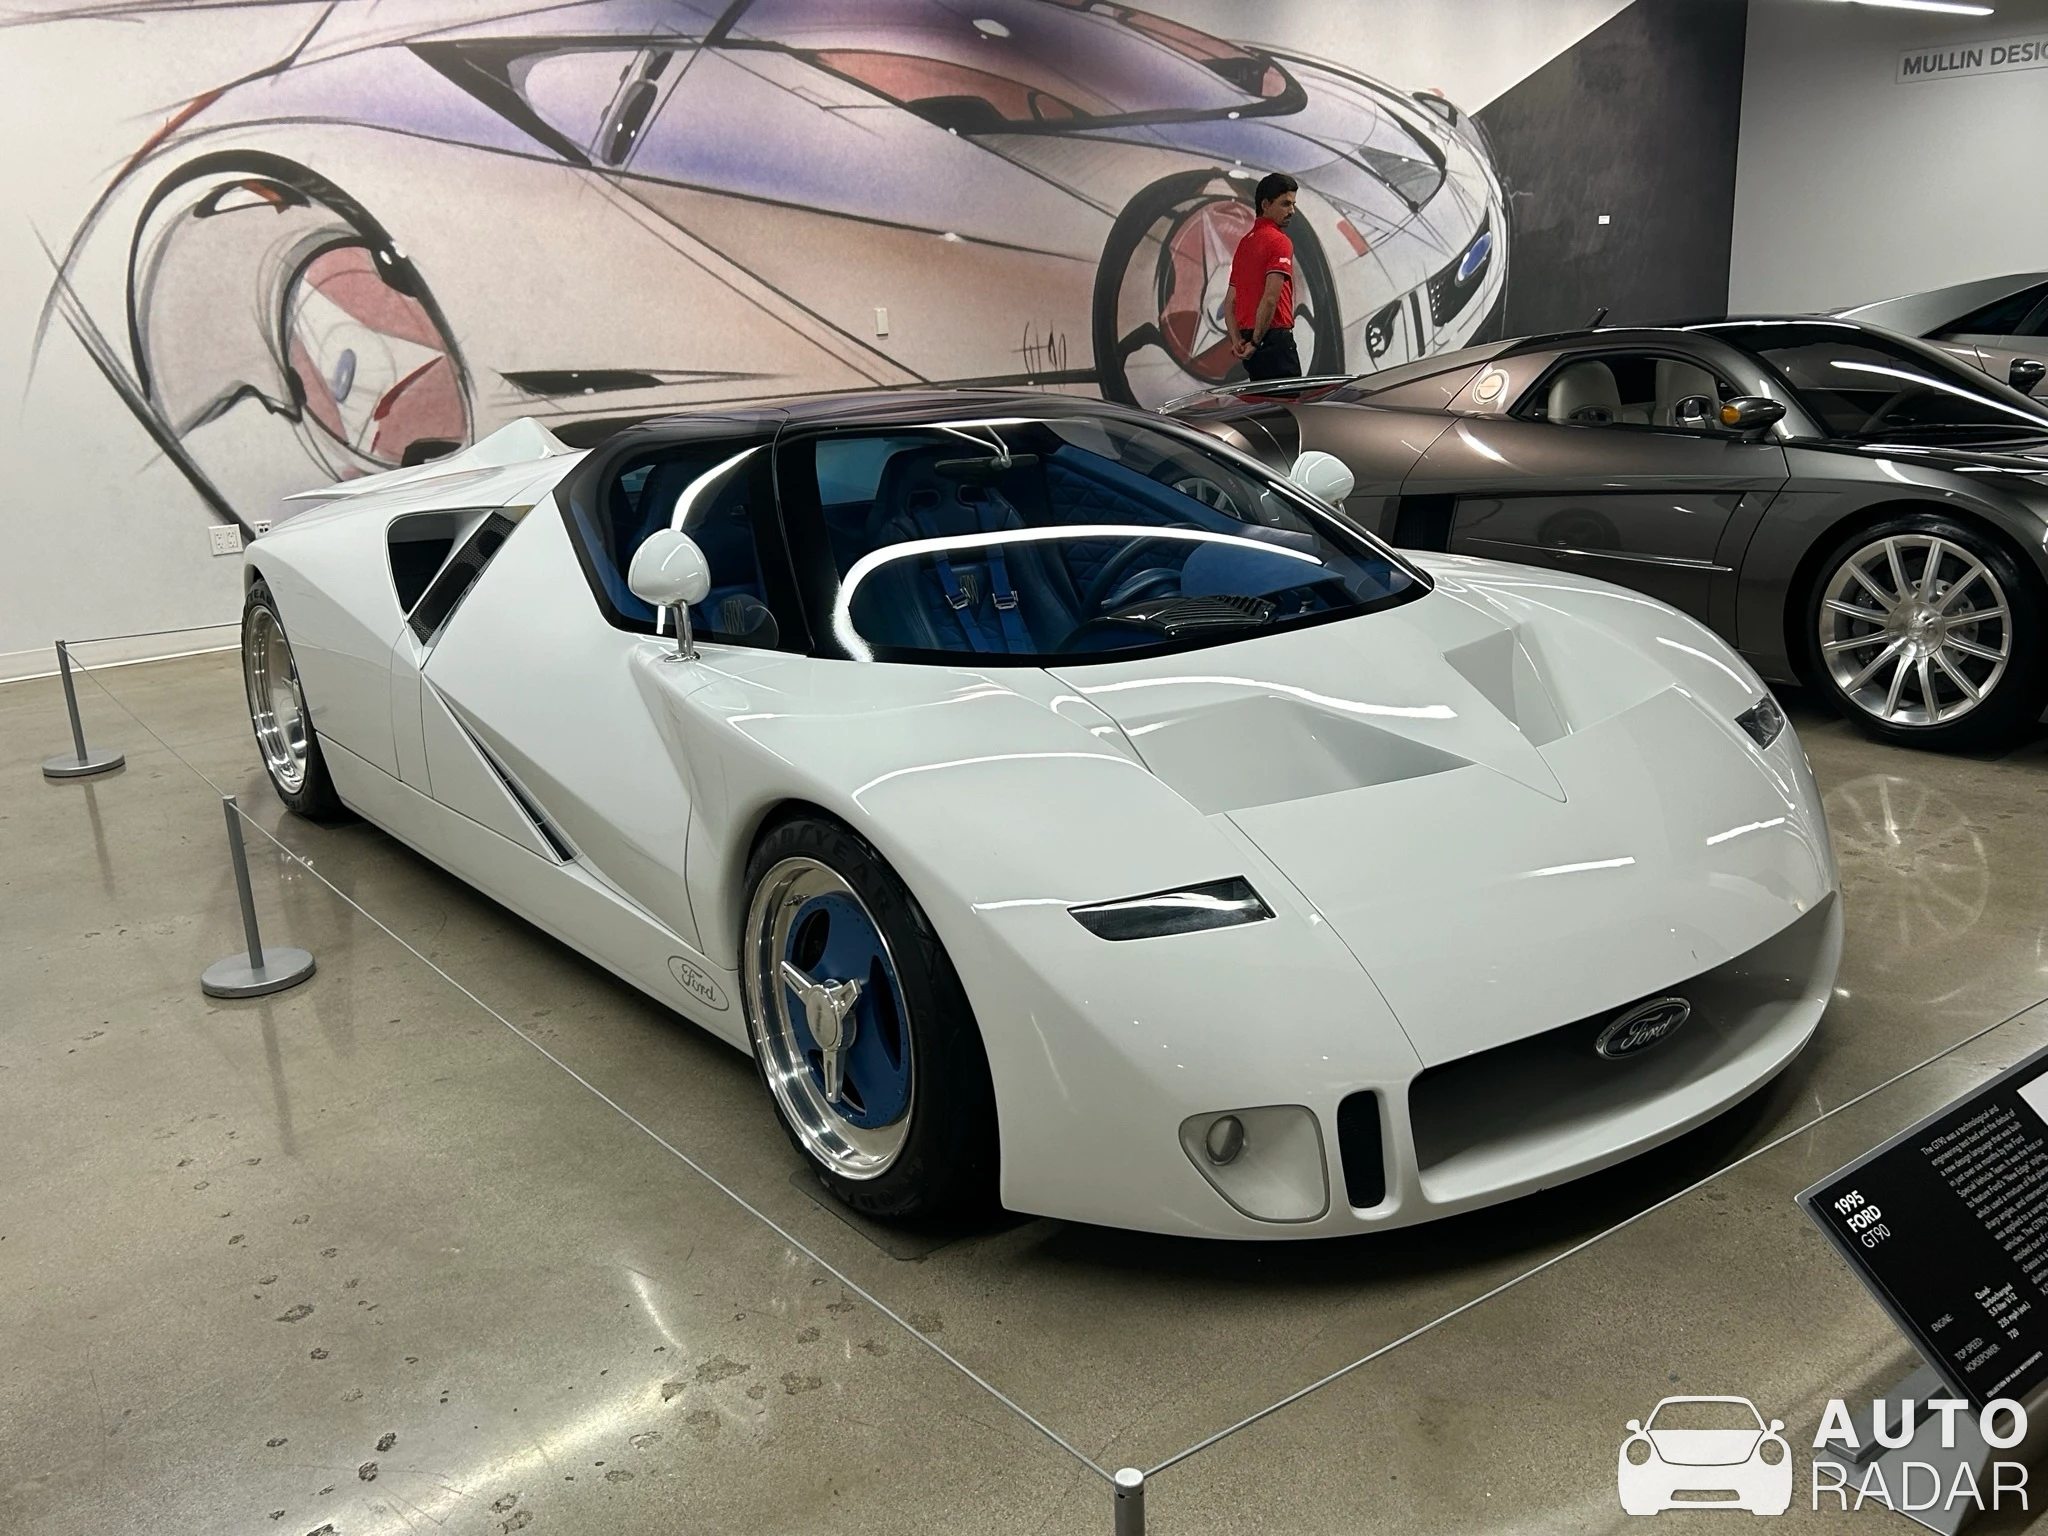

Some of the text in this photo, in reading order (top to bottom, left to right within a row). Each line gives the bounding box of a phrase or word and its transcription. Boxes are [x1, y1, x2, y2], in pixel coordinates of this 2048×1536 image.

[1902, 48, 1983, 76] MULLIN
[681, 963, 716, 1002] Ford
[1620, 1012, 1673, 1050] Ford
[1920, 1146, 1934, 1155] The
[1931, 1136, 1947, 1150] GT90
[1988, 1104, 1999, 1115] and
[1968, 1140, 1993, 1157] language
[1981, 1152, 2000, 1166] months
[2010, 1134, 2025, 1146] Ford
[1956, 1181, 1977, 1198] Special
[1973, 1172, 1994, 1186] Vehicle
[1834, 1190, 1865, 1215] 1995
[1846, 1205, 1881, 1233] FORD
[1861, 1223, 1891, 1248] GT90
[1982, 1282, 2013, 1308] turbocharged
[1997, 1317, 2010, 1328] 235
[2007, 1328, 2019, 1339] 720
[1954, 1348, 1967, 1361] TOP
